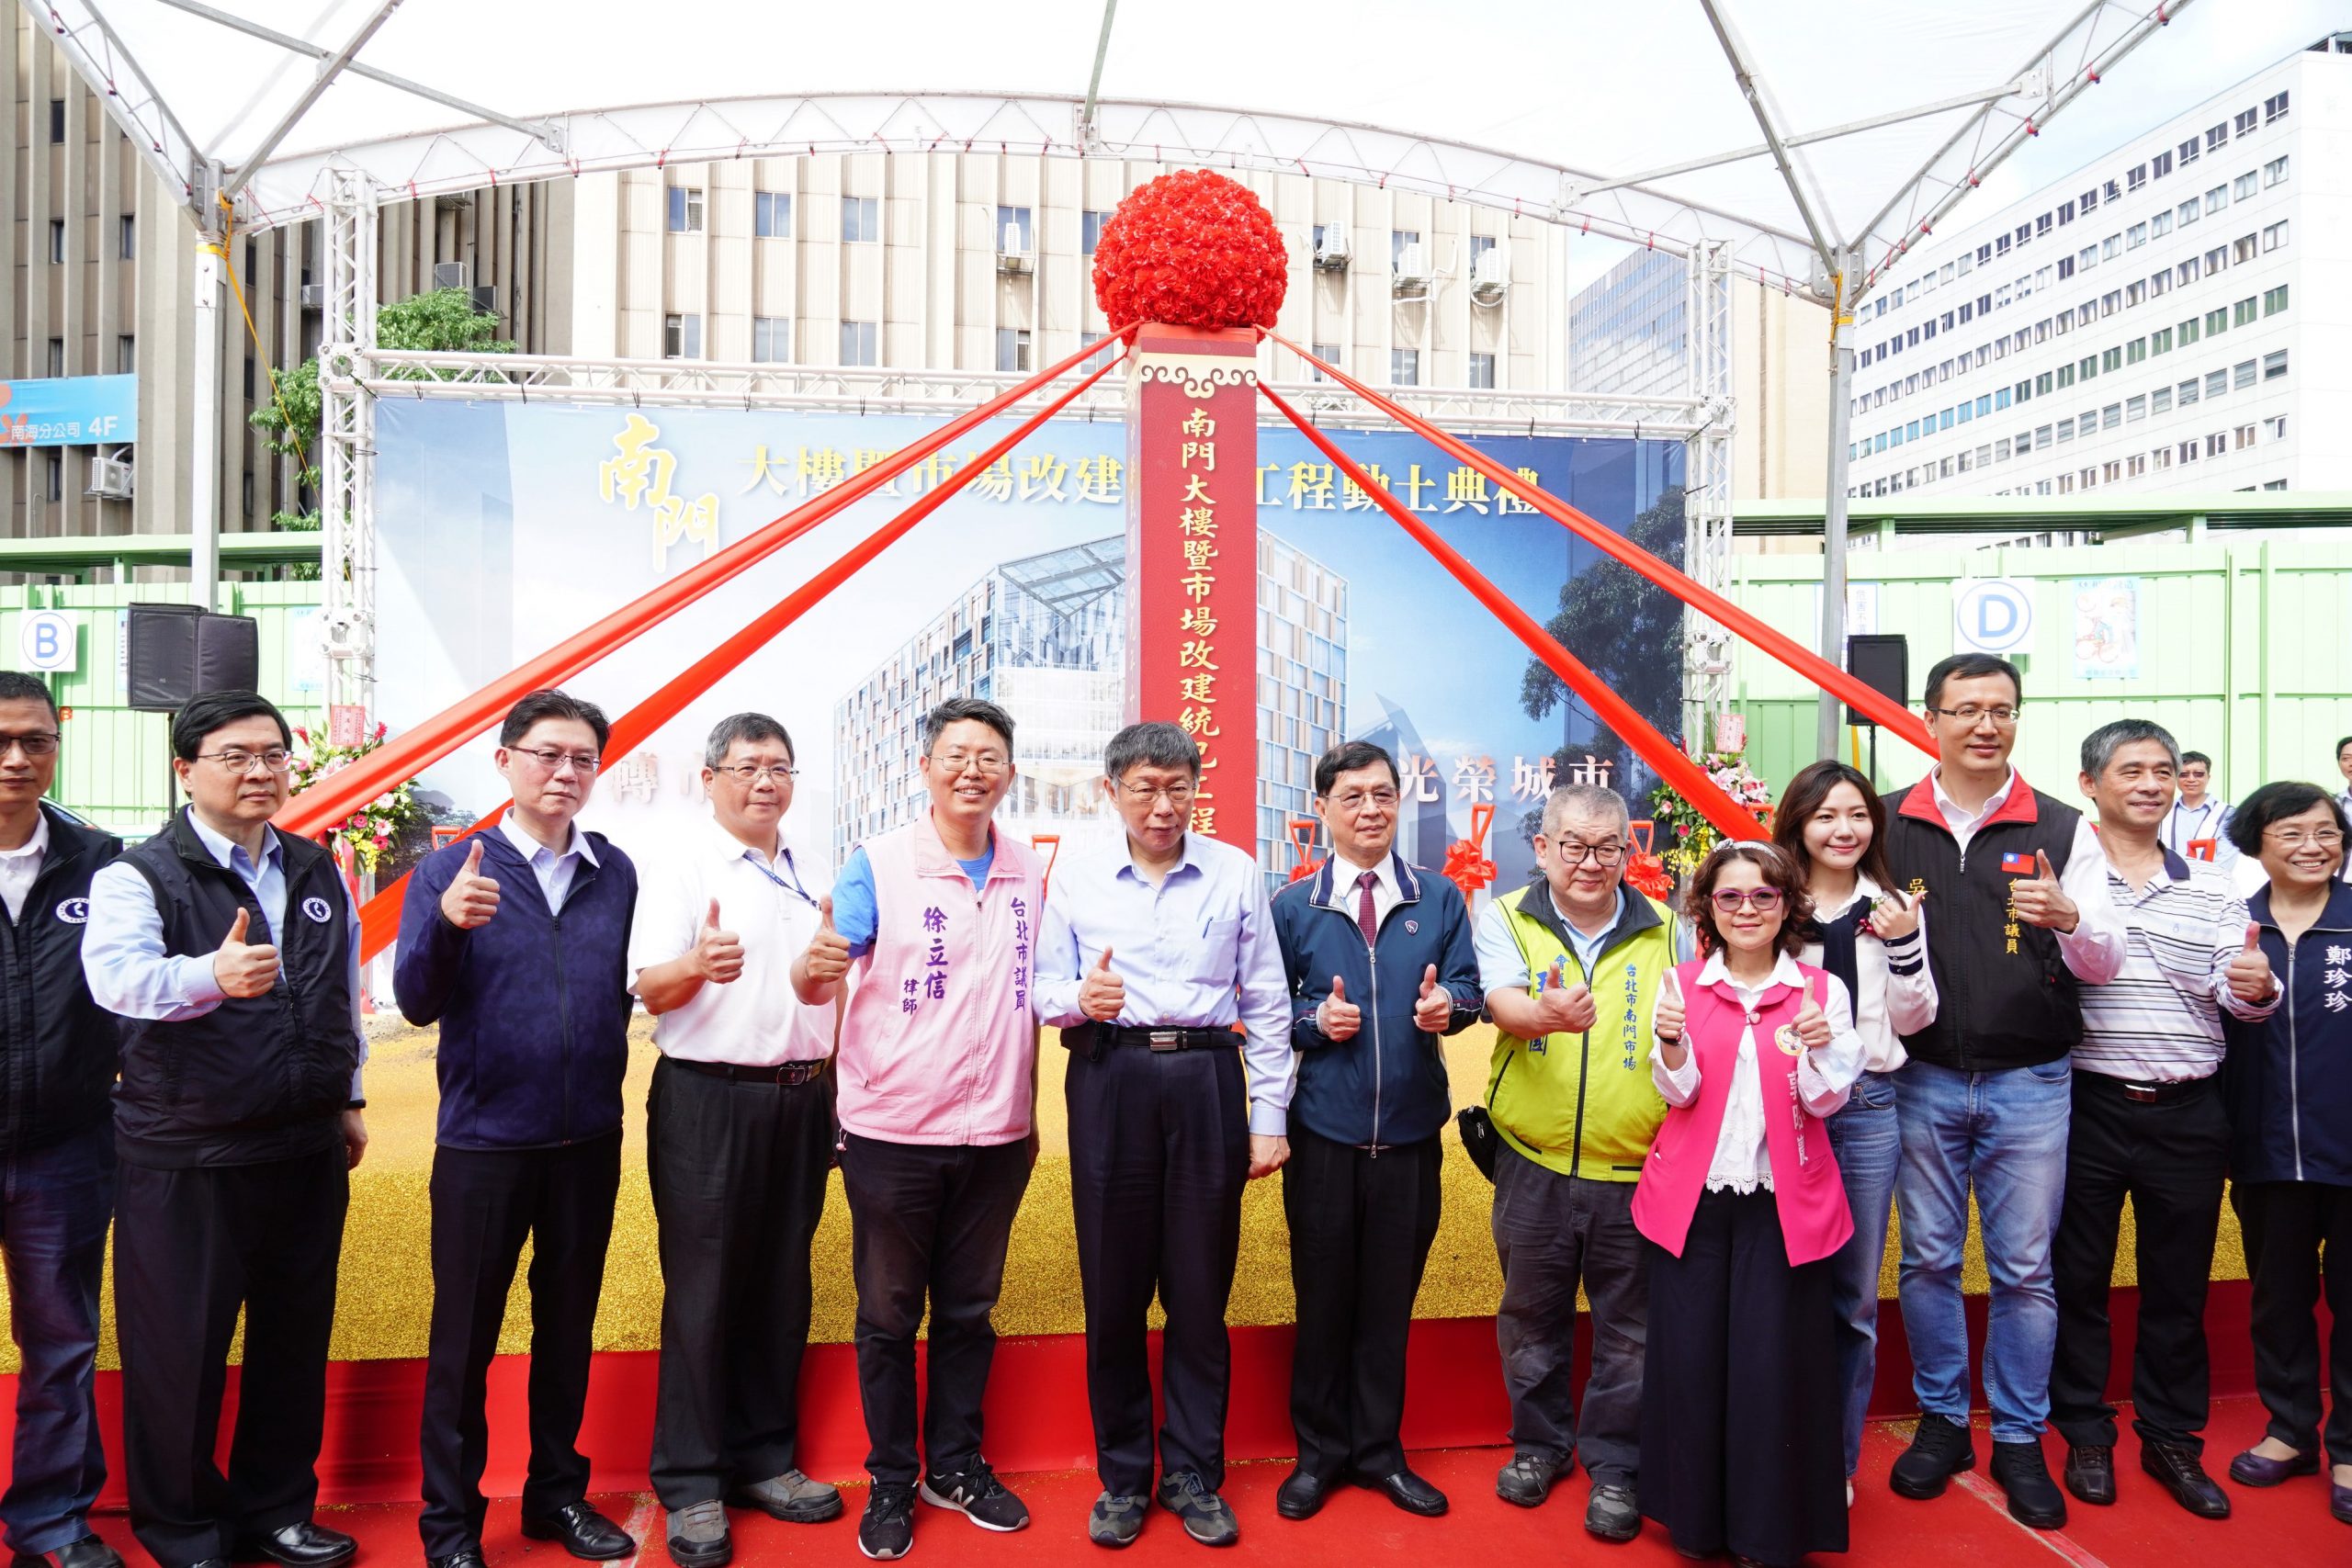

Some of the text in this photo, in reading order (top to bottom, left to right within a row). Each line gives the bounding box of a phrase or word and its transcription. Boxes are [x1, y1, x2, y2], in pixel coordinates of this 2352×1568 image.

[11, 415, 119, 440] 南海分公司 4F
[36, 623, 59, 659] B
[1978, 593, 2018, 638] D
[922, 906, 949, 999] 徐立信
[1011, 897, 1029, 1011] 台北市議員
[2323, 944, 2352, 1013] 鄭珍珍
[902, 978, 920, 1015] 律師
[1623, 963, 1638, 1071] 台北市南門市場
